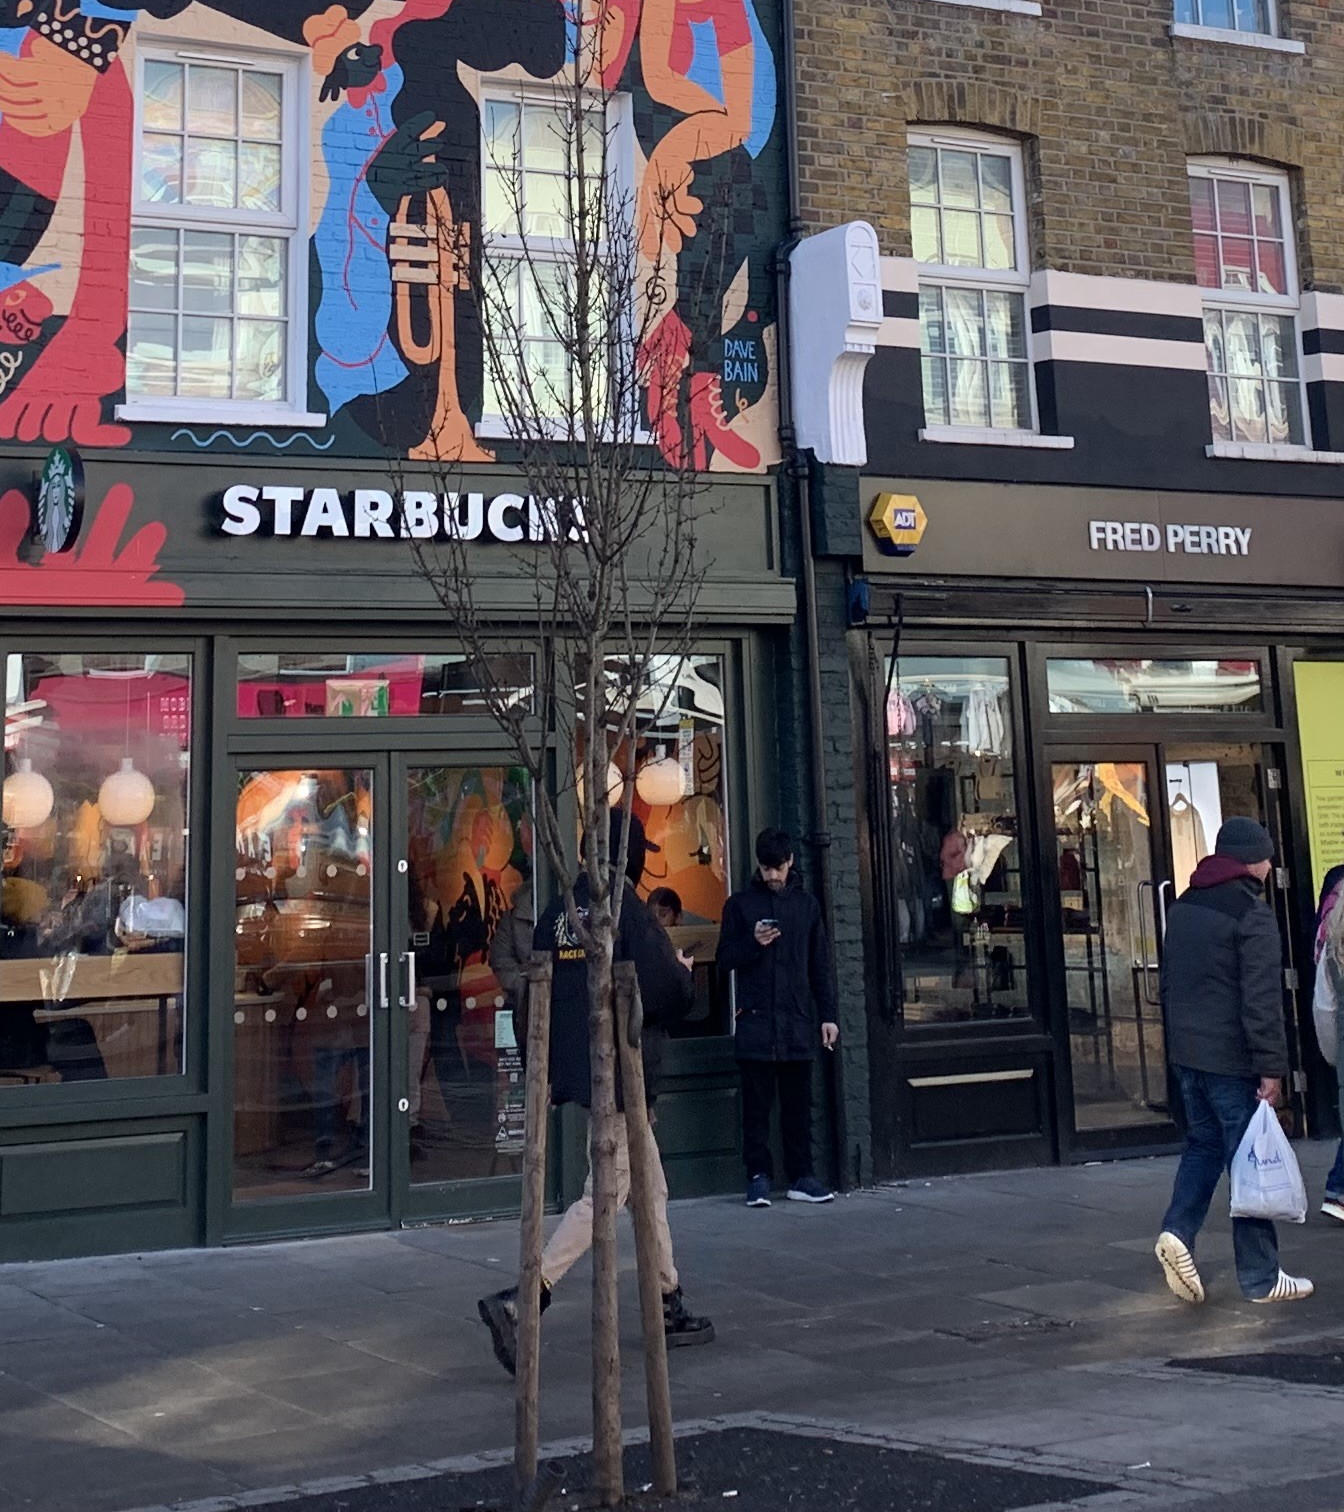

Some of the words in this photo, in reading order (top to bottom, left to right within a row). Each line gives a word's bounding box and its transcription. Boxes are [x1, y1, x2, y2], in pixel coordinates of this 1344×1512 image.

[724, 338, 756, 359] DAVE
[724, 359, 759, 383] BAIN
[894, 511, 916, 528] ADT
[1088, 520, 1161, 552] FRED
[1166, 524, 1252, 556] PERRY
